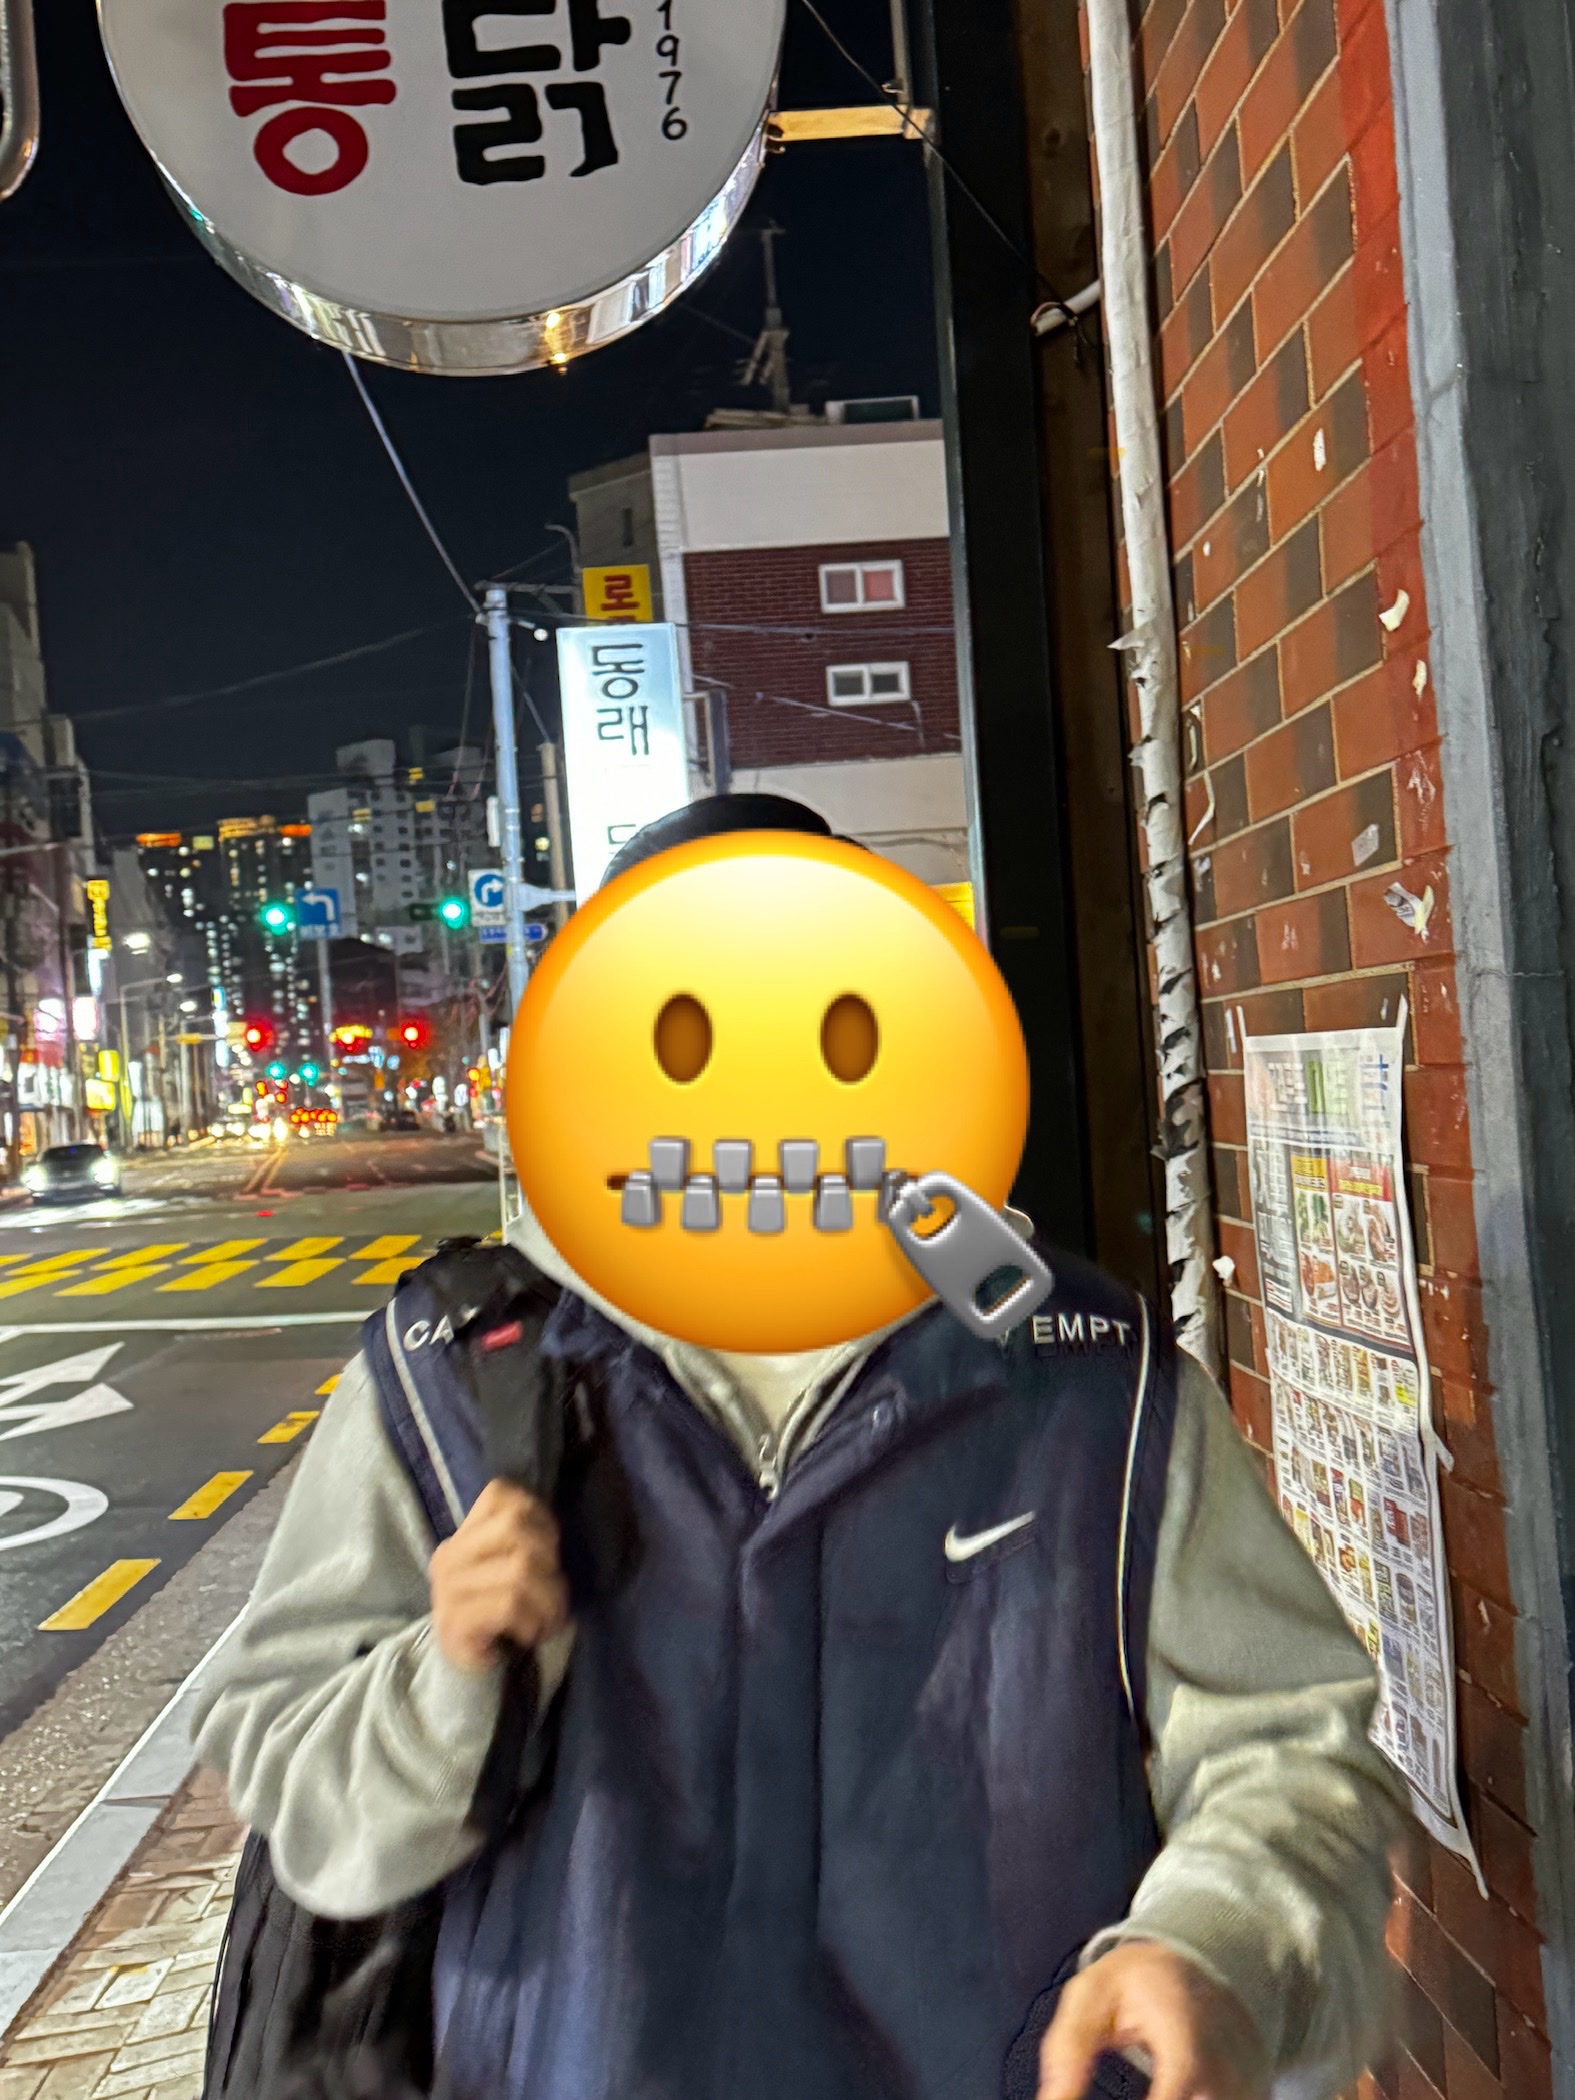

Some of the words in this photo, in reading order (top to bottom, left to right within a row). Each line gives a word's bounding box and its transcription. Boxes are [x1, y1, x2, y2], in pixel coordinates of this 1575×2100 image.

[656, 0, 687, 140] 1976
[591, 644, 650, 755] 동래
[1032, 1312, 1132, 1346] EMPT
